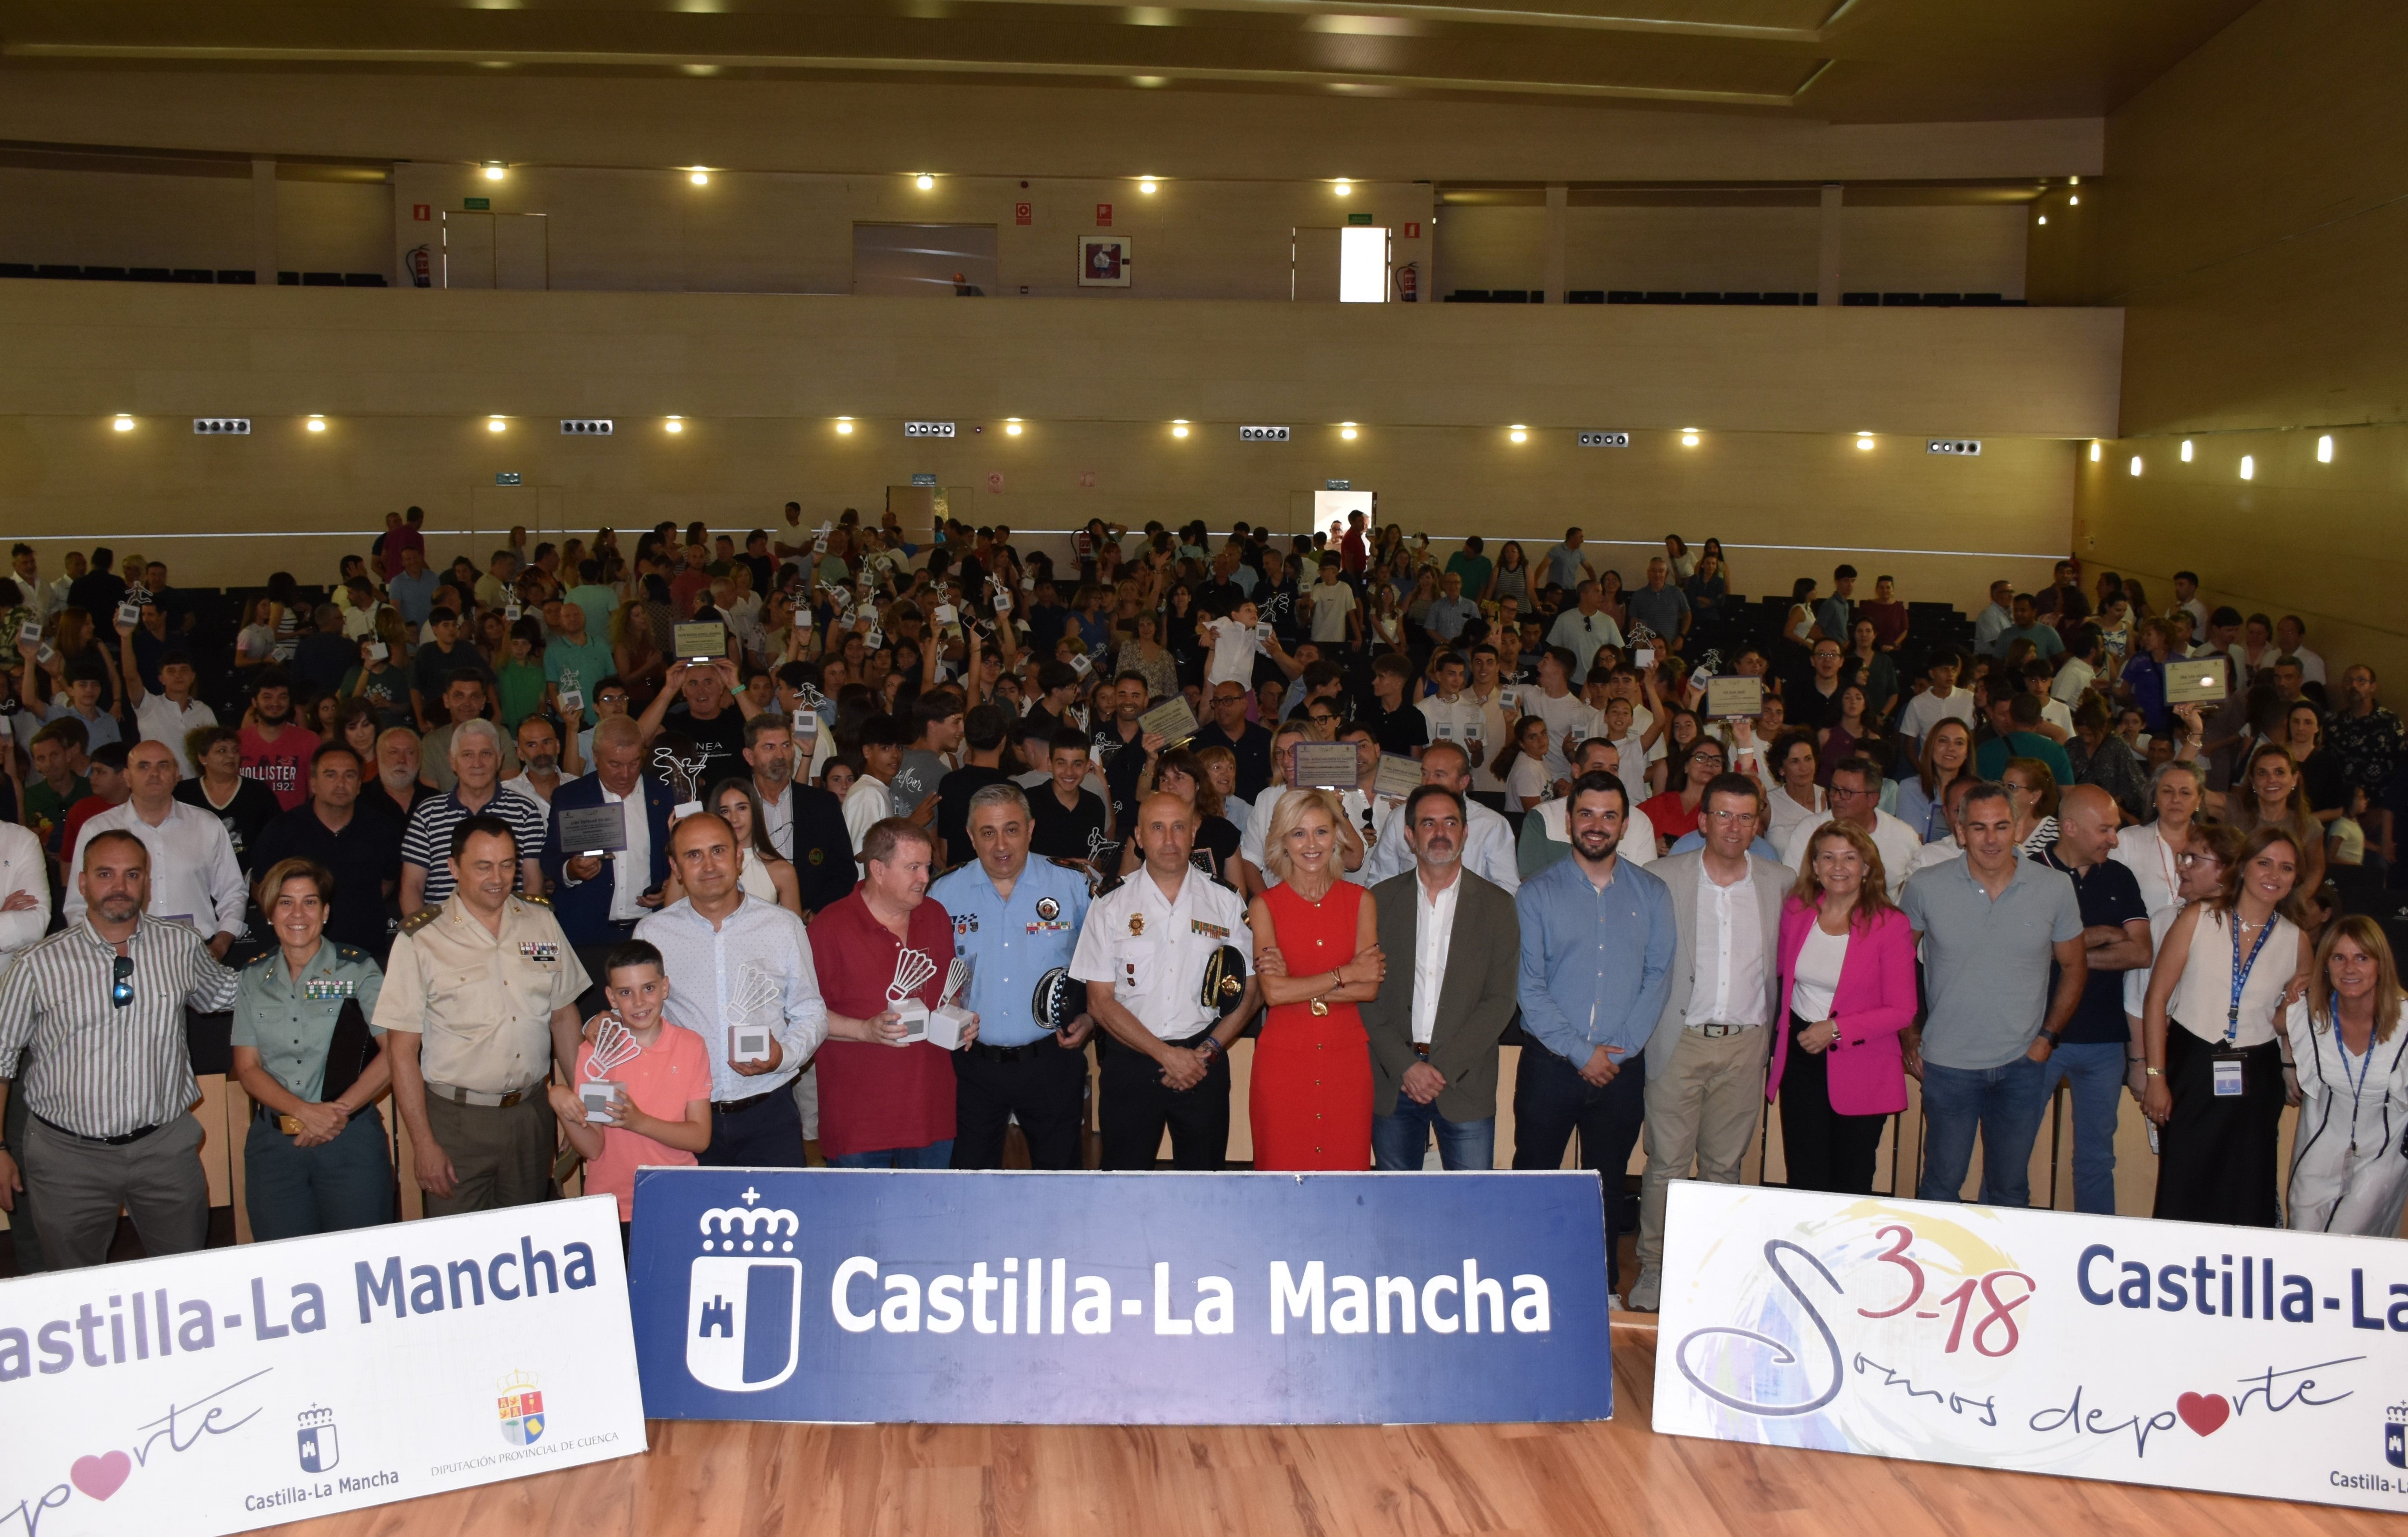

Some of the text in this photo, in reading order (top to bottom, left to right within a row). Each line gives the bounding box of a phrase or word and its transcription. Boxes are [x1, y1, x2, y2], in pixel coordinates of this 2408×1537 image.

[239, 766, 296, 780] HOLLISTER
[272, 782, 295, 791] 1922
[0, 1235, 597, 1382] astilla-La Mancha
[832, 1256, 1551, 1336] Castilla-La Mancha
[1857, 1225, 2036, 1358] 3-18
[2077, 1244, 2408, 1332] Castilla-La
[431, 1432, 619, 1476] DIPUTACIÓN PROVINCIAL DE CUENCA
[245, 1470, 399, 1511] Castilla-La Mancha
[2329, 1470, 2408, 1494] Castilla-L
